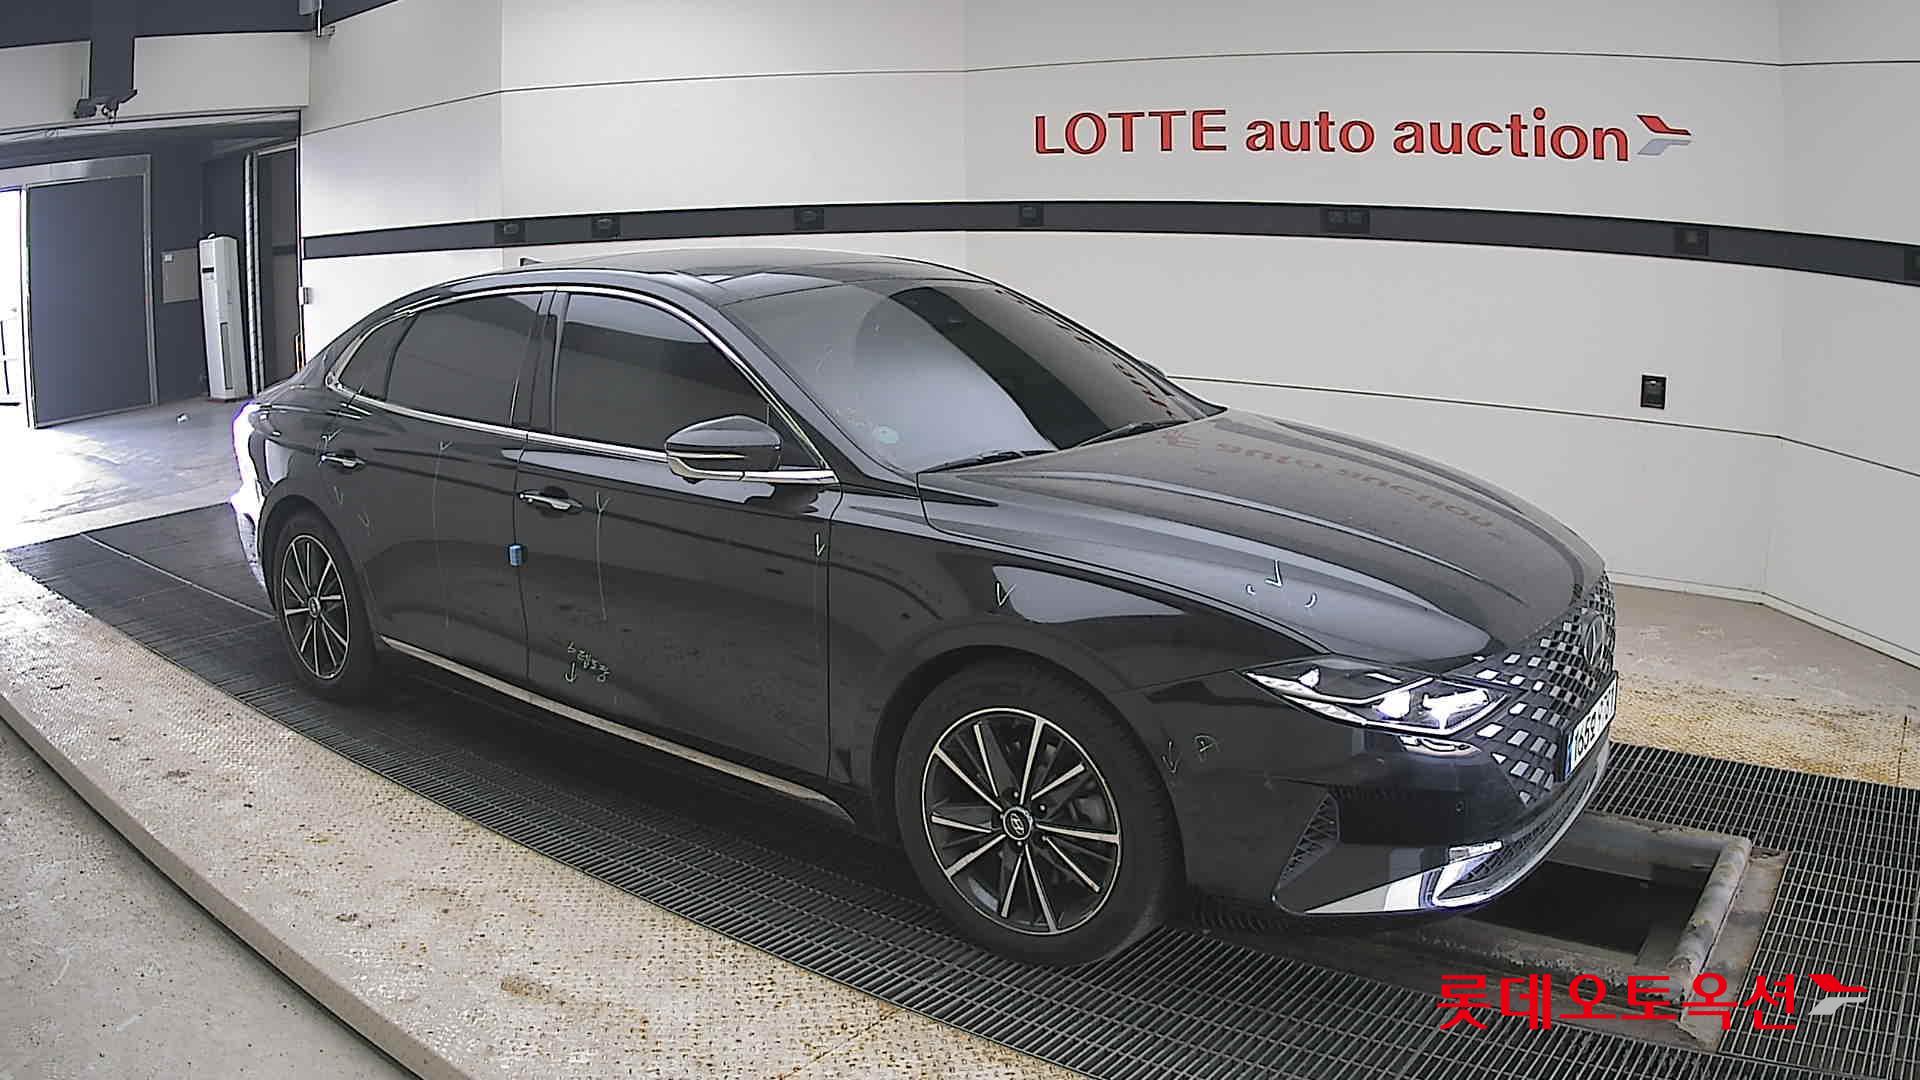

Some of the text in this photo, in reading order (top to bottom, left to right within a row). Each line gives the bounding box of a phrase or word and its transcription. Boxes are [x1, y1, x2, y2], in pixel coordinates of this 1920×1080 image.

[1035, 107, 1629, 162] LOTTE auto auction
